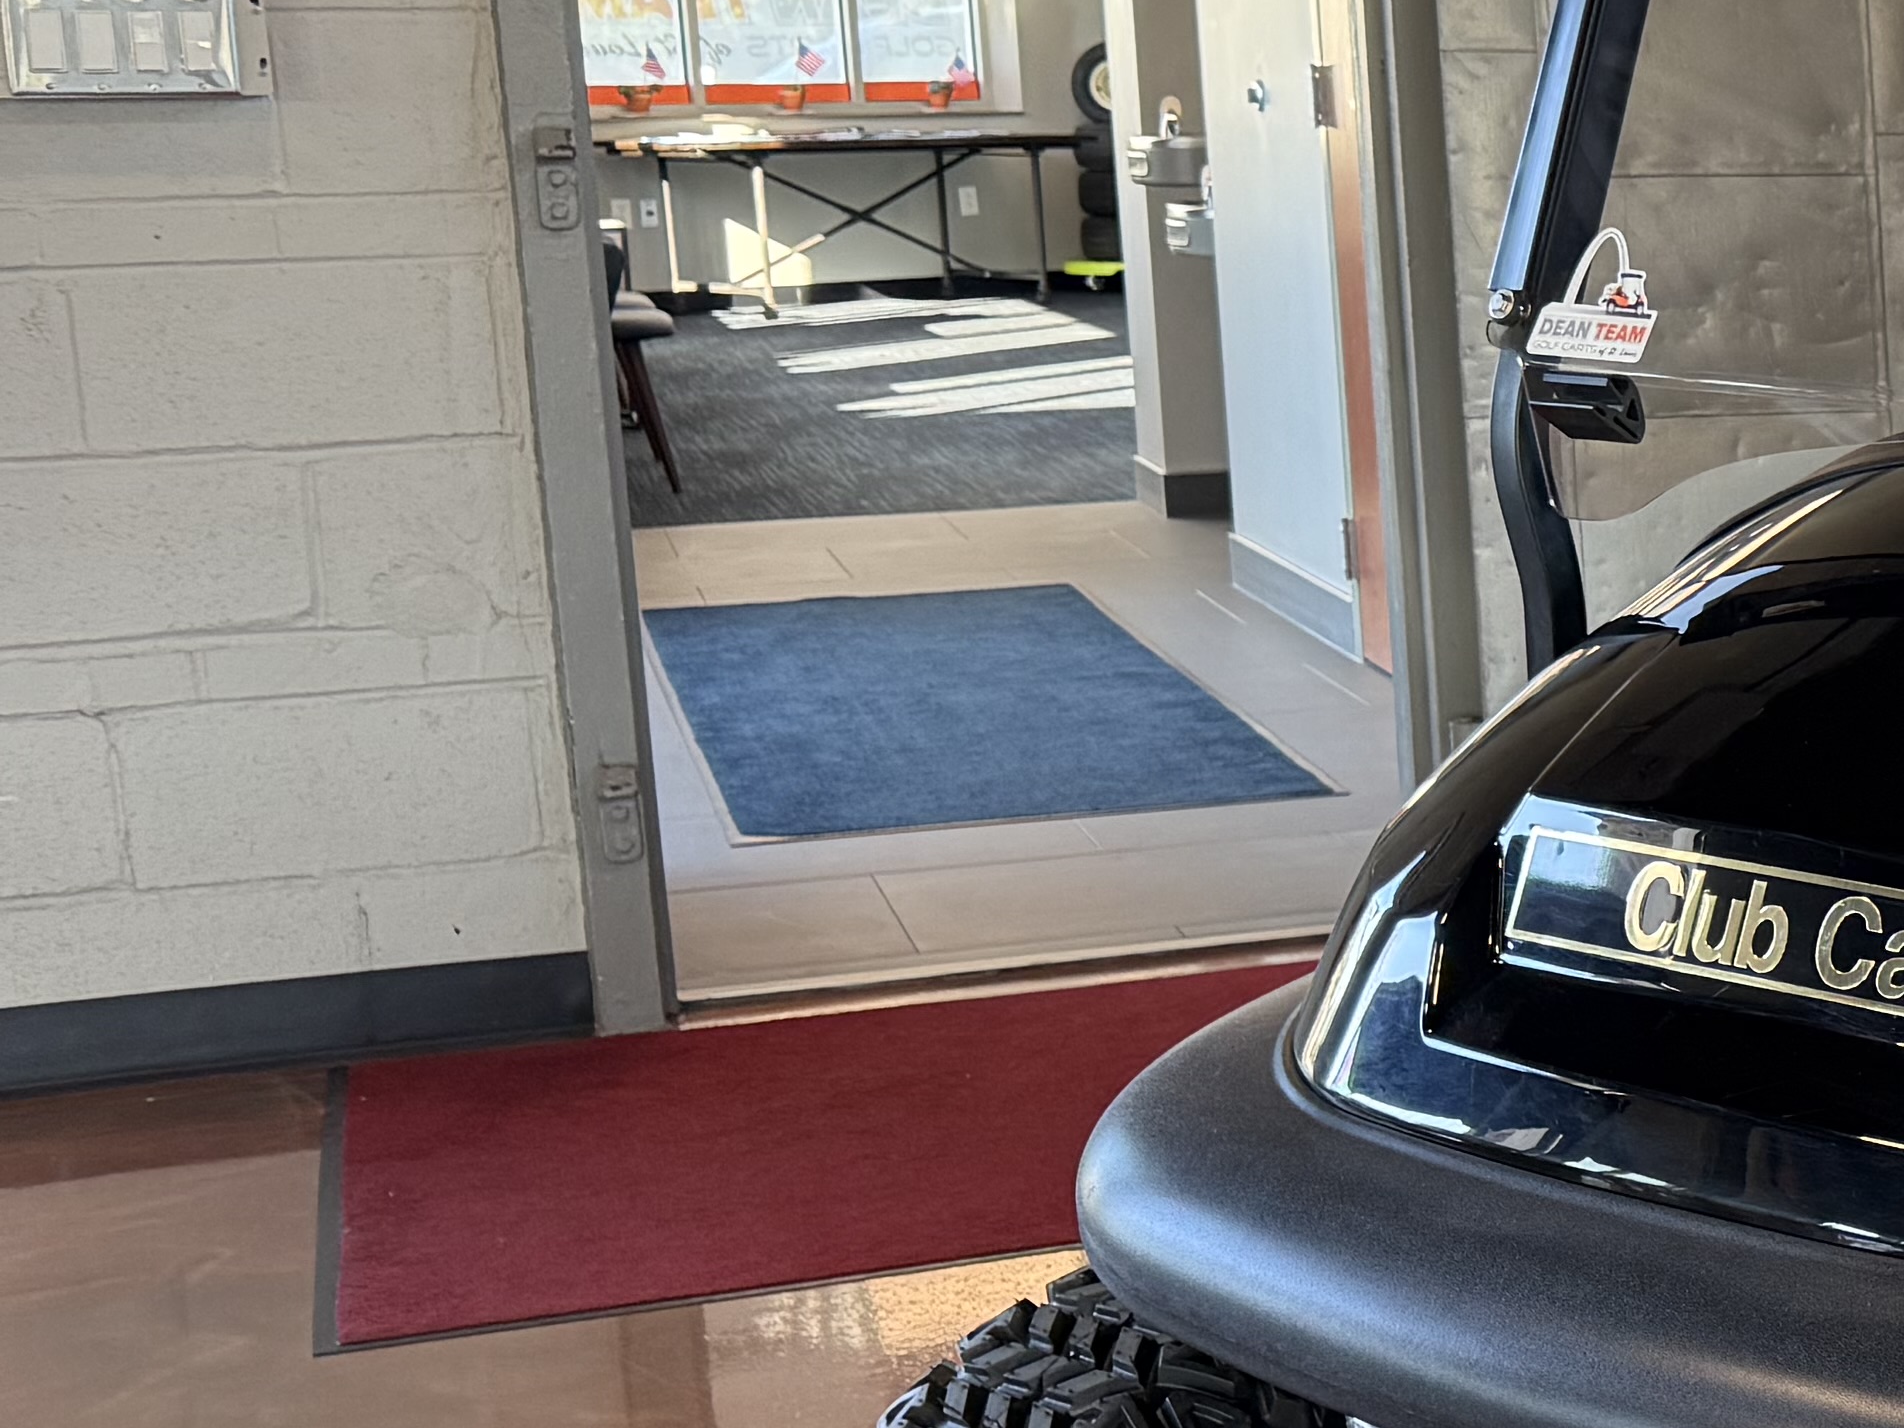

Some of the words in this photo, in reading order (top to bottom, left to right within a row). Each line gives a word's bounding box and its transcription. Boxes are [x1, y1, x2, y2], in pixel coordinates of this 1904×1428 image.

[1538, 319, 1592, 340] DEAN
[1595, 323, 1647, 343] TEAM
[1534, 339, 1559, 350] GOLF
[1561, 341, 1597, 353] CARTS
[1625, 859, 1789, 974] Club
